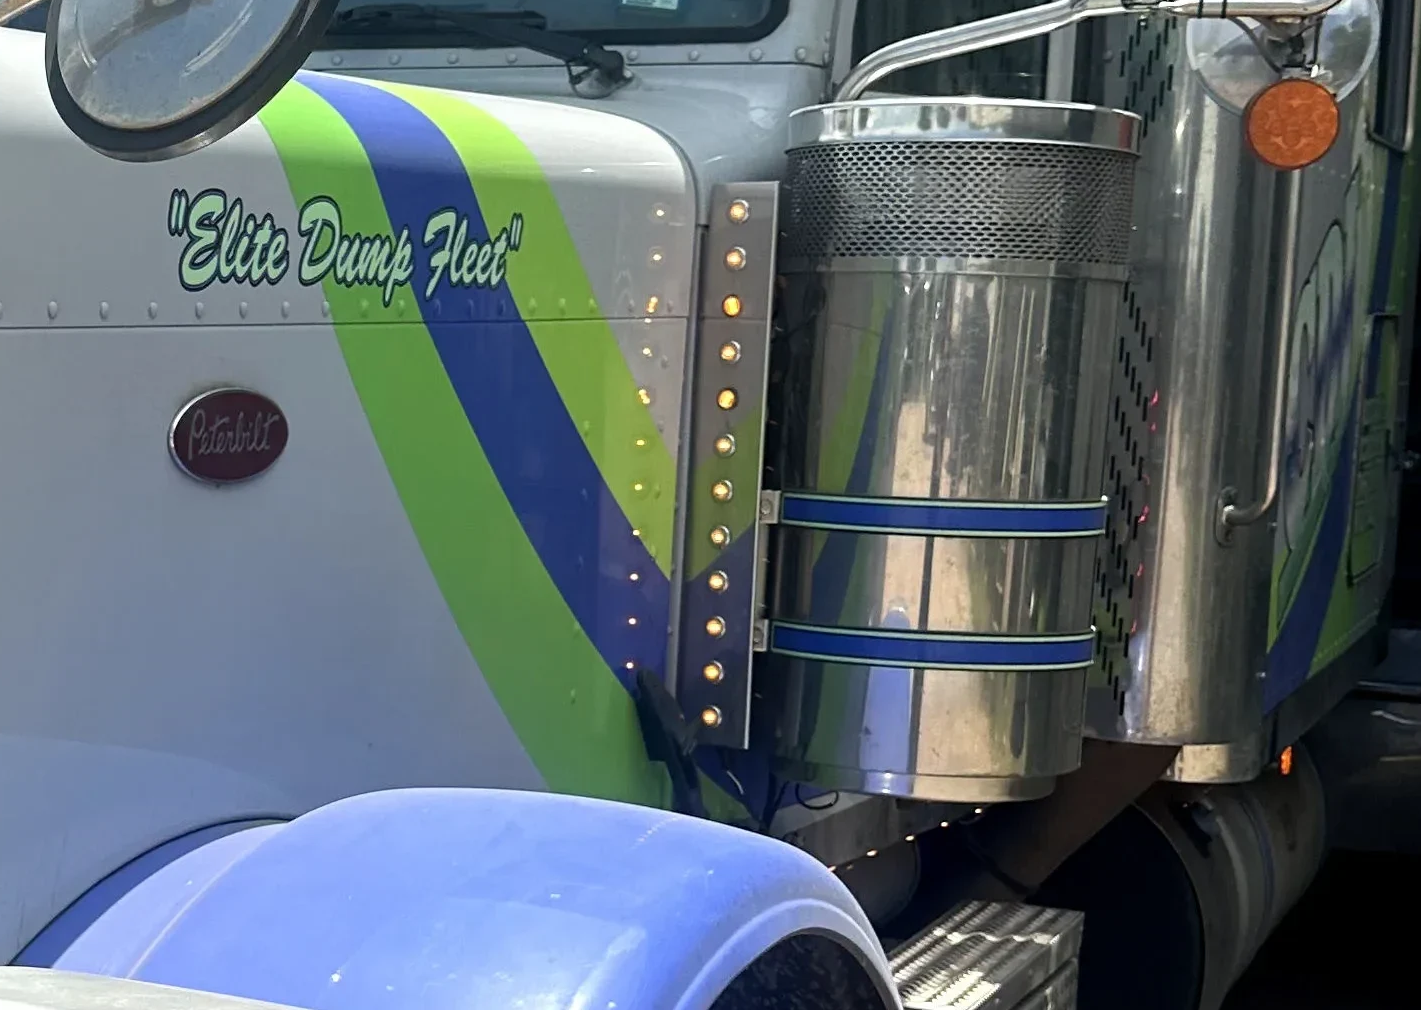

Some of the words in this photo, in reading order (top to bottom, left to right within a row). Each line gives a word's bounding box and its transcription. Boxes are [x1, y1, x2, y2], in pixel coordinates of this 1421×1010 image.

[168, 188, 289, 292] "Elite
[298, 195, 414, 308] Dump
[423, 206, 523, 302] Fleet"
[188, 409, 280, 461] Peterbilt
